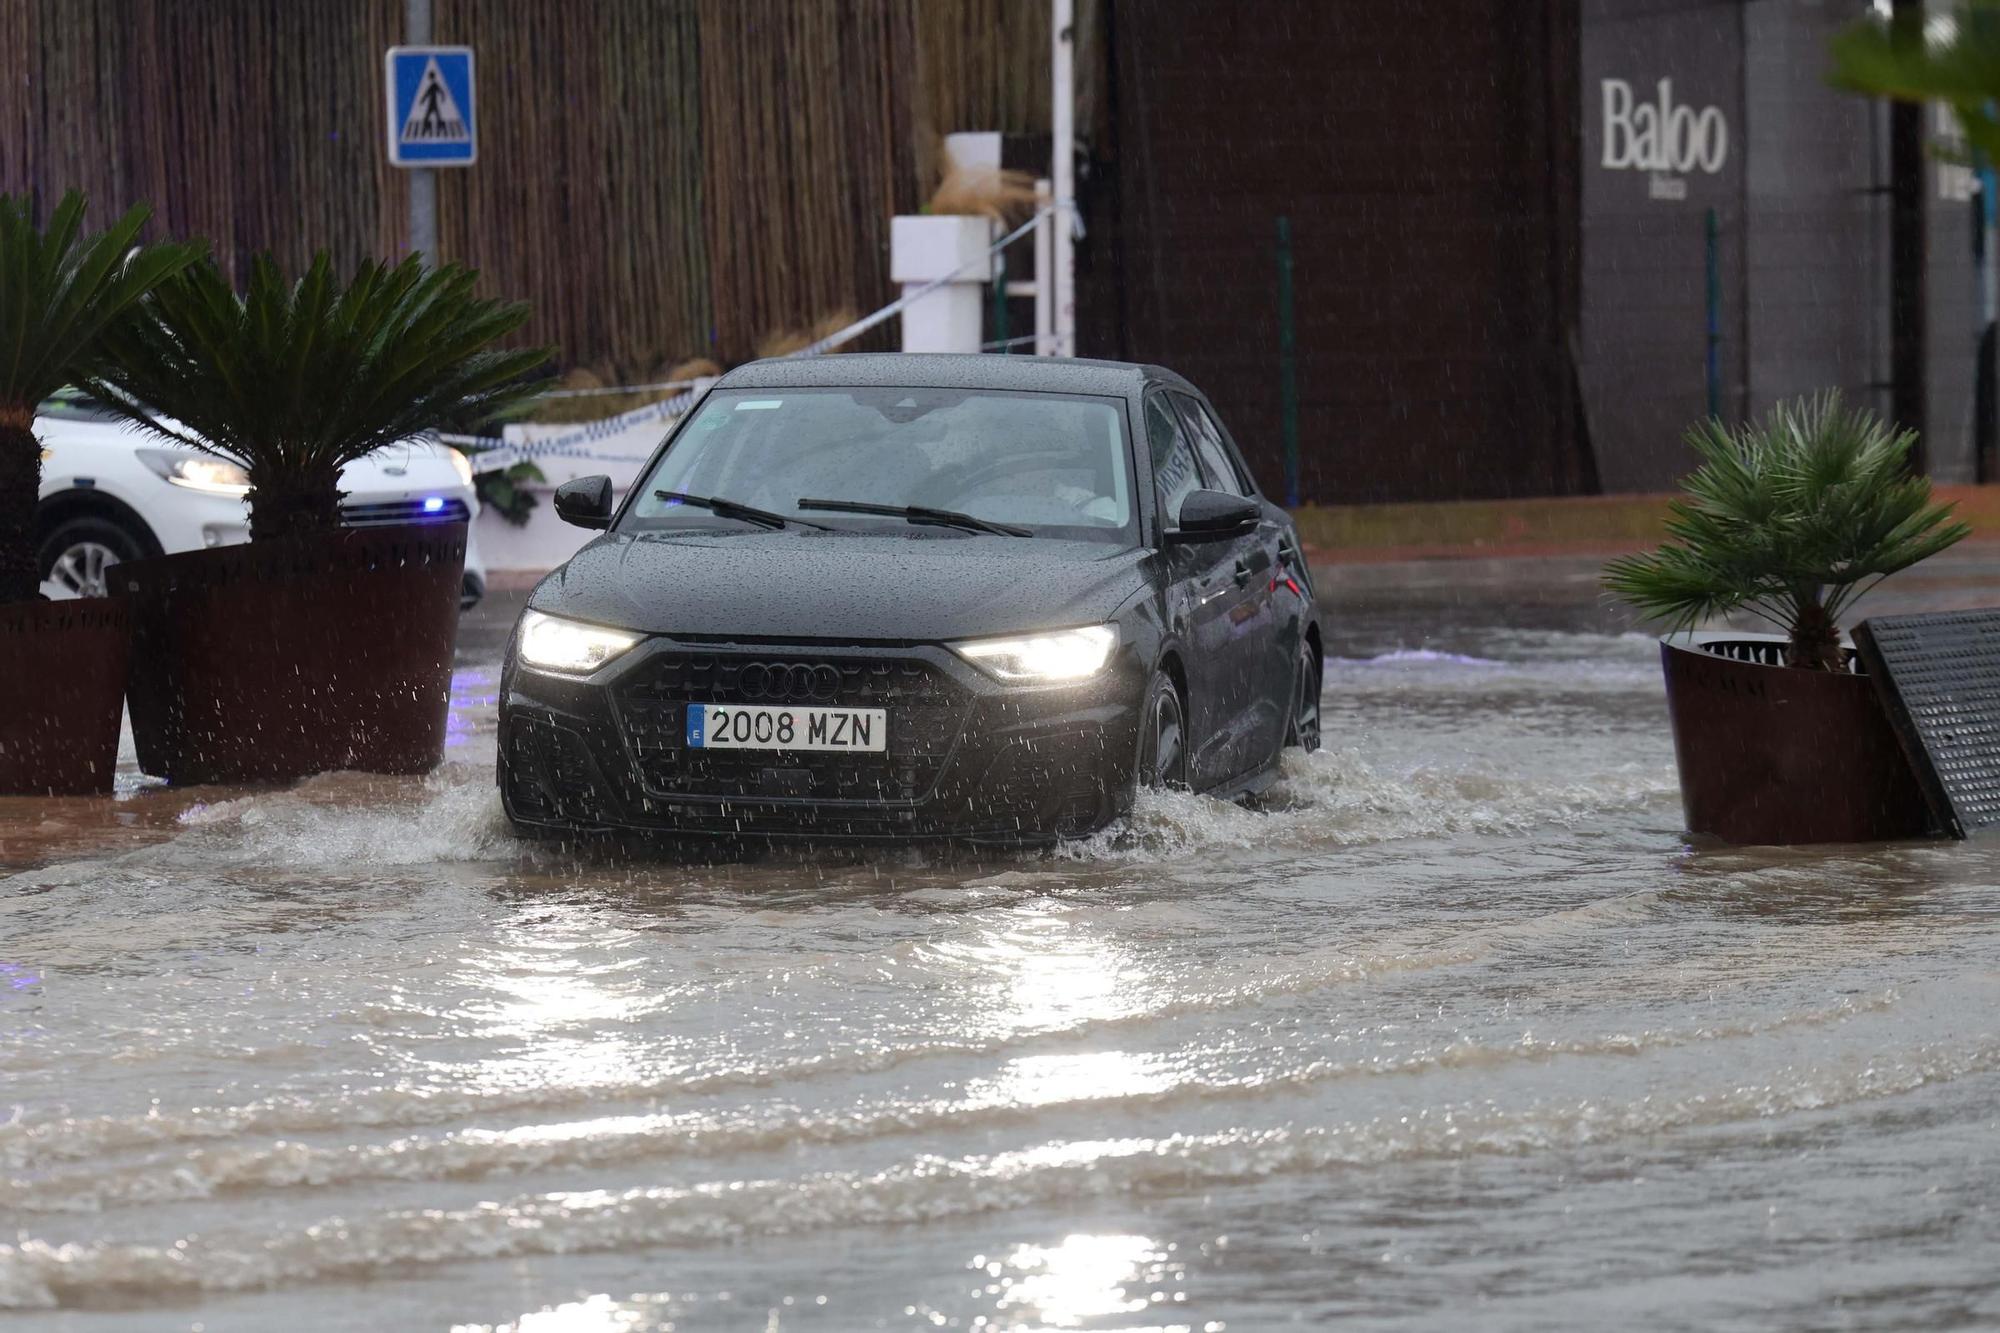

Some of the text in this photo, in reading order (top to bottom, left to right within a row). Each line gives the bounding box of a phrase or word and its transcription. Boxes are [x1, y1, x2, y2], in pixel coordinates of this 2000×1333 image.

[1600, 76, 1729, 174] Baloo
[693, 729, 700, 739] E
[711, 710, 871, 746] 2008 MZN
